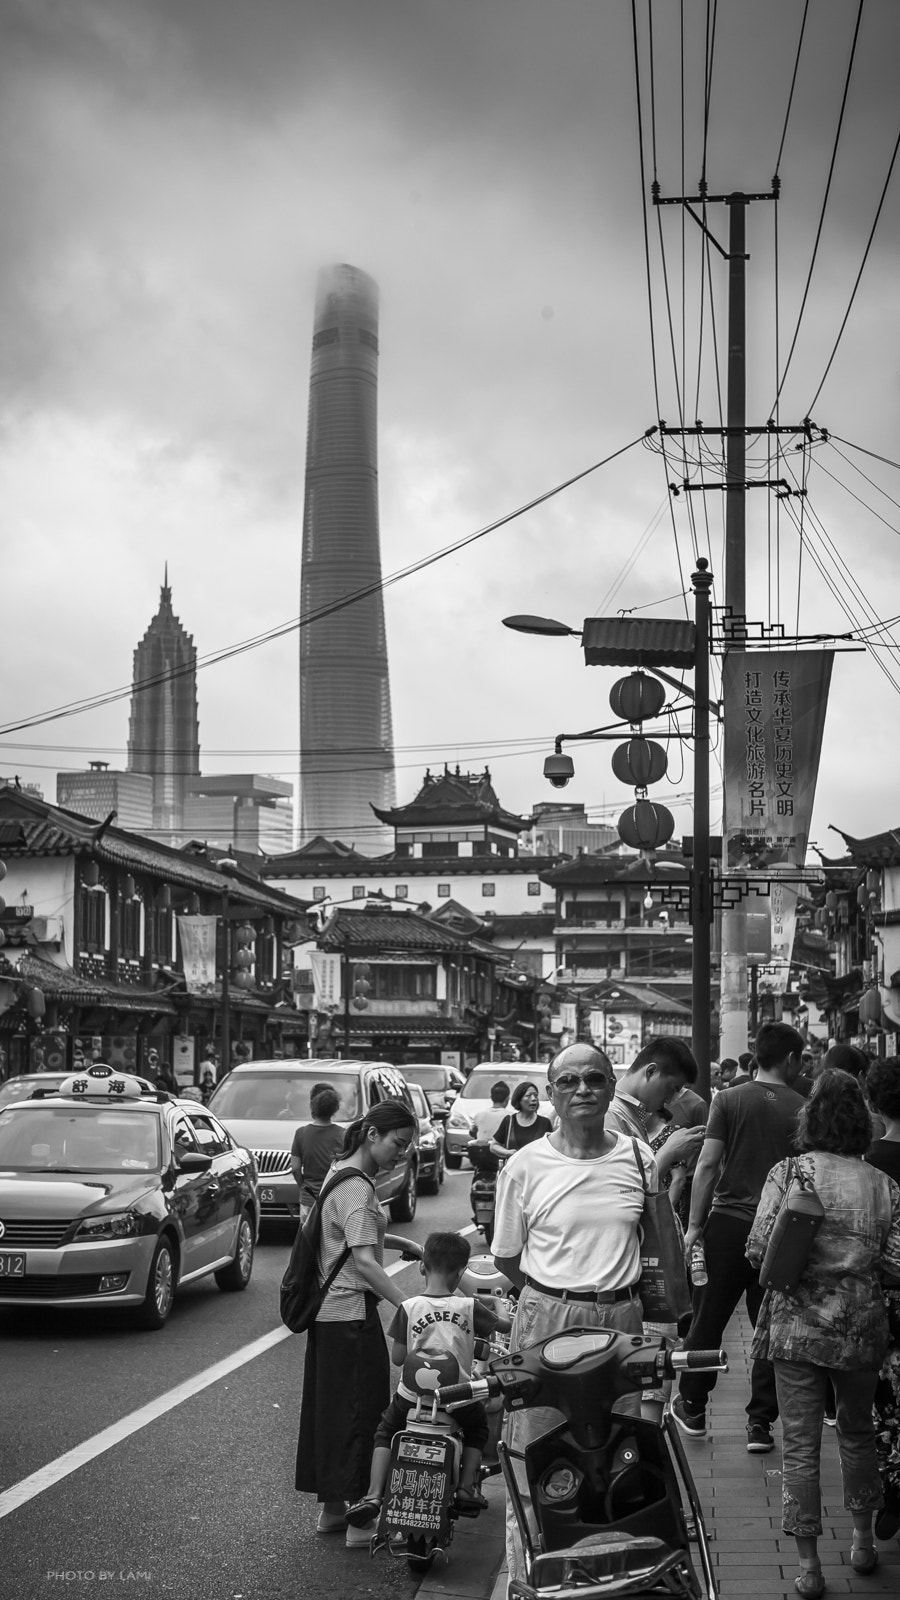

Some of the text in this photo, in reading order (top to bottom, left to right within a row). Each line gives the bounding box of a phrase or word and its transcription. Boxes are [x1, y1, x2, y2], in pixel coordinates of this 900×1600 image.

[744, 671, 766, 816] 打造文化旅游名片
[772, 670, 794, 816] 传承华夏历史文明
[261, 1189, 273, 1201] 63
[390, 1468, 446, 1500] 以马内利
[388, 1494, 443, 1515] 小胡车行
